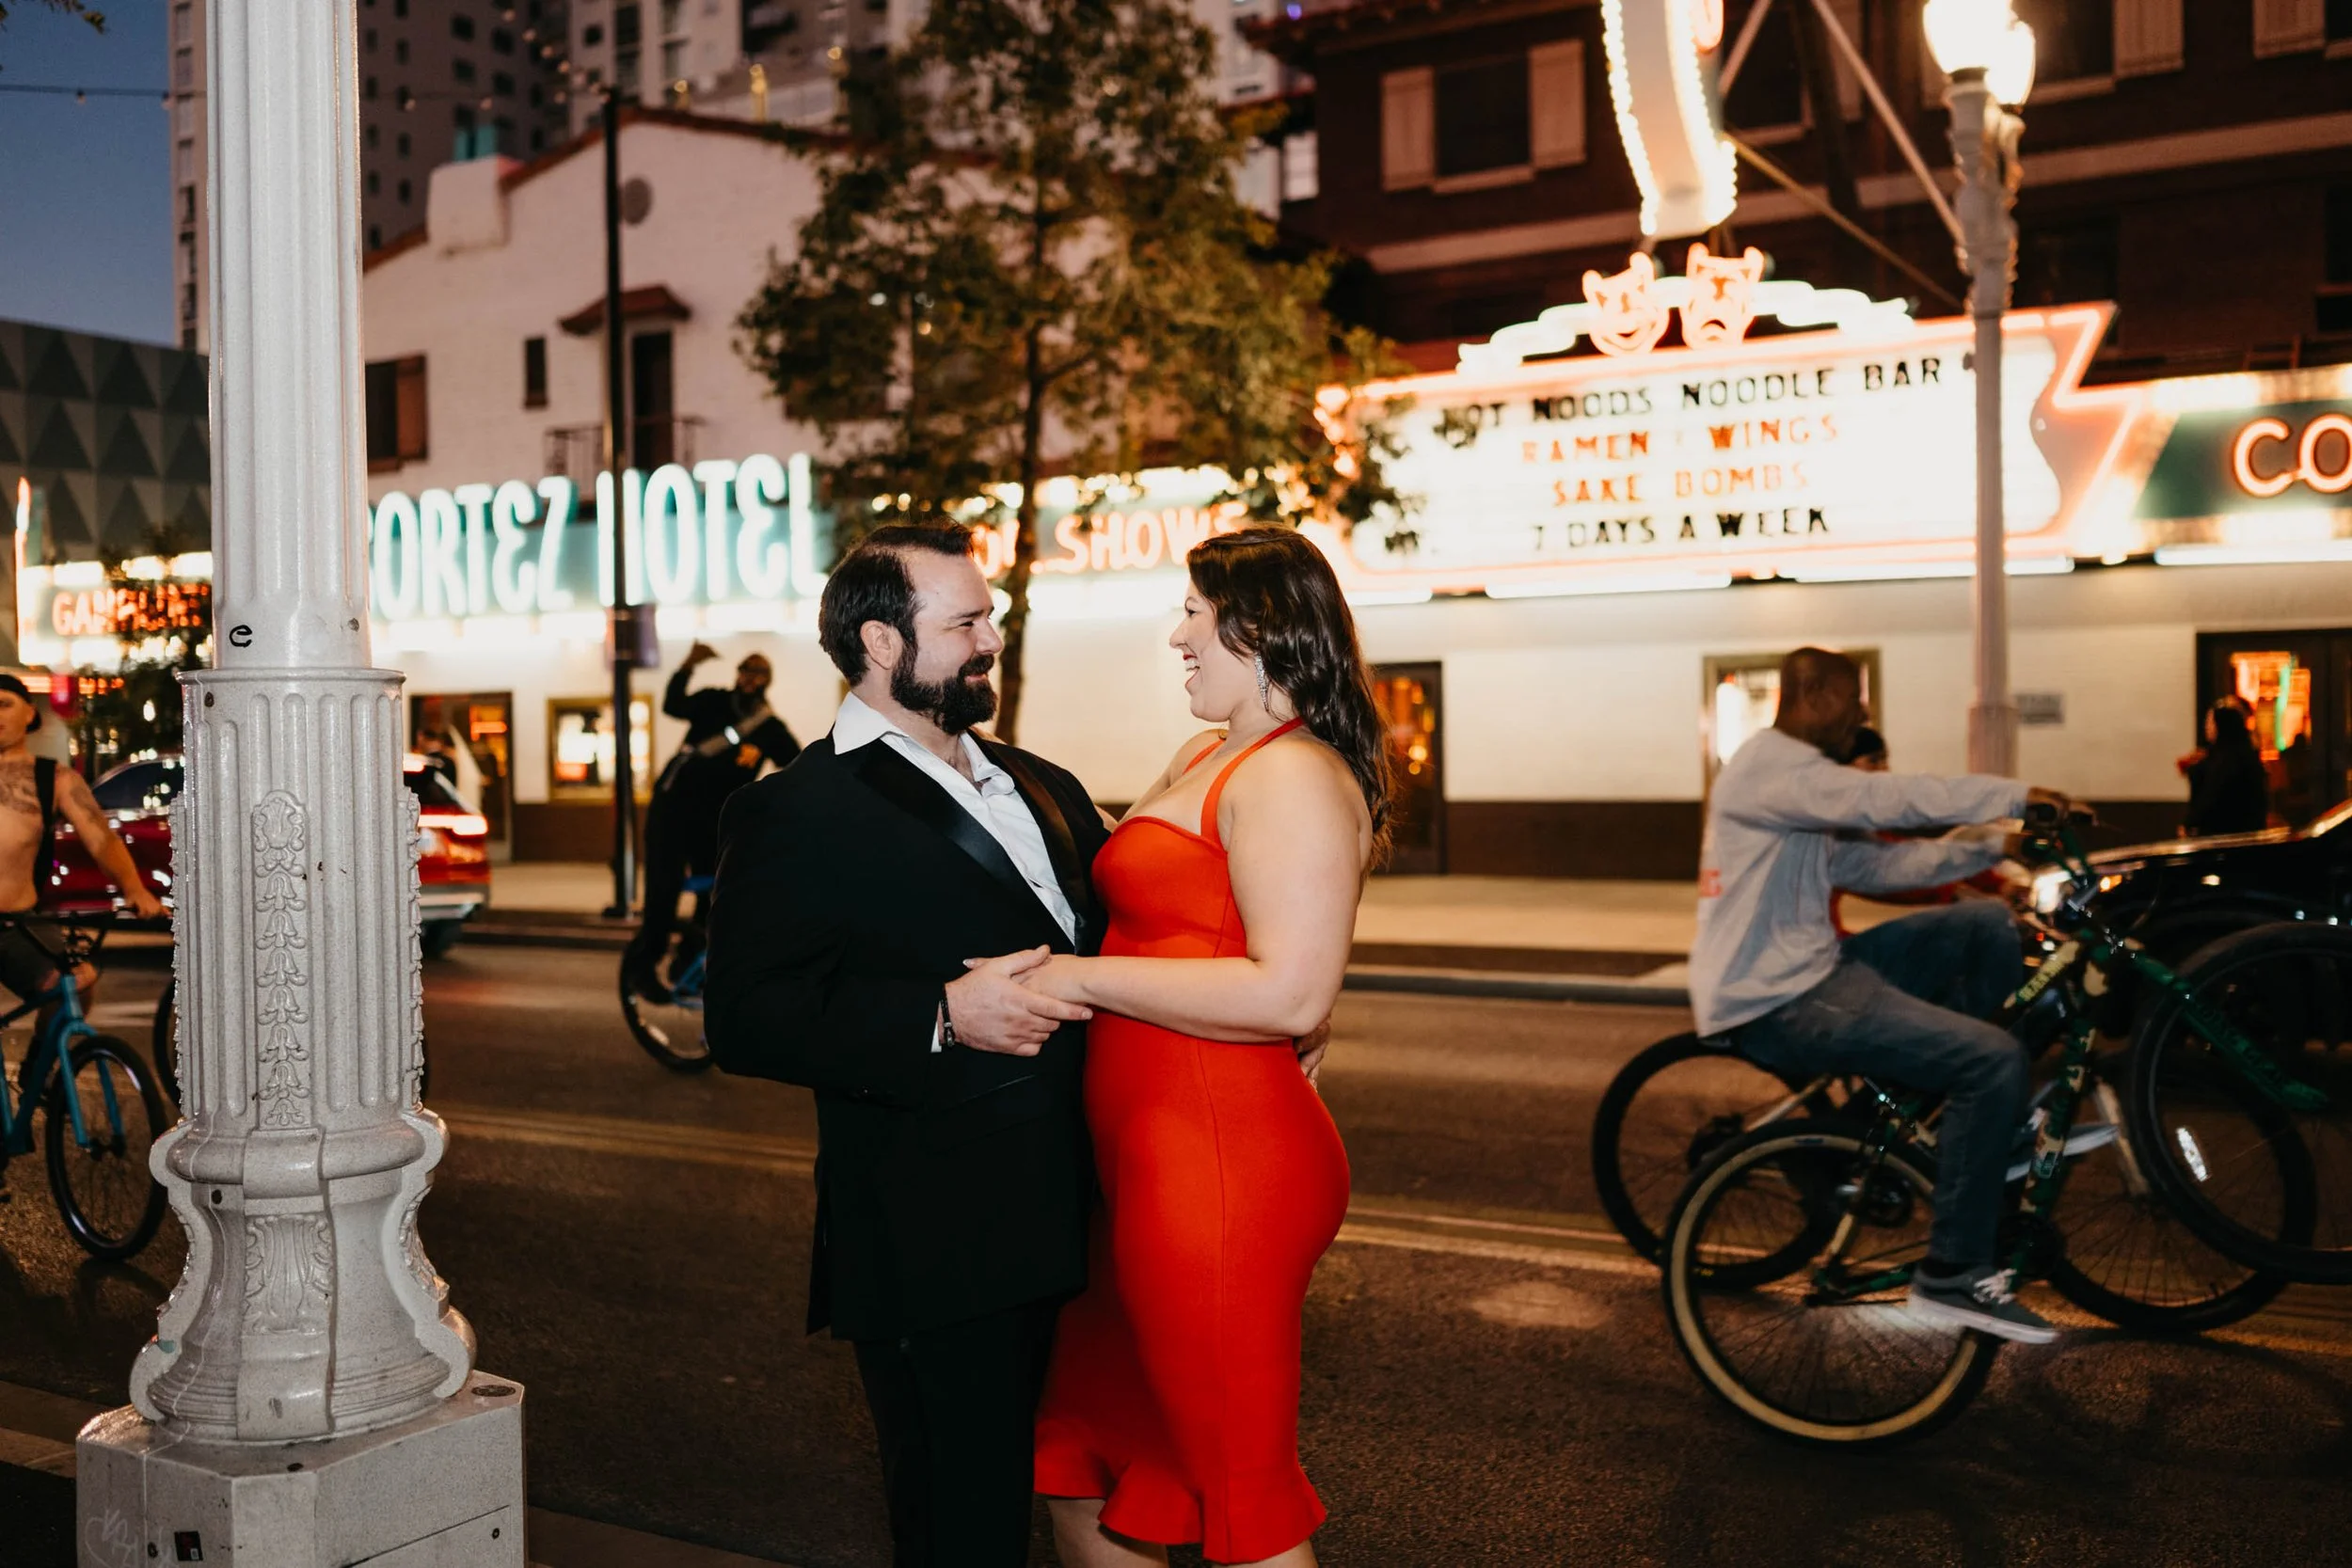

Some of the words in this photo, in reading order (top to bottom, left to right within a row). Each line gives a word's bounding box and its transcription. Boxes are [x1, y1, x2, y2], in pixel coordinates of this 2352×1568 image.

[1532, 387, 1653, 421] NOODS
[1682, 368, 1835, 409] NOODLE
[1864, 357, 1941, 391] BAR
[1521, 430, 1650, 463] RAMEN
[1708, 414, 1837, 451] WINGS
[1553, 473, 1644, 507] SAKE
[1675, 461, 1809, 499] BOMBS
[368, 475, 576, 623] ORTEZ
[596, 451, 831, 608] HOTEL
[1567, 516, 1656, 548] DAYS
[1678, 515, 1696, 542] A
[1716, 507, 1829, 538] WEEK
